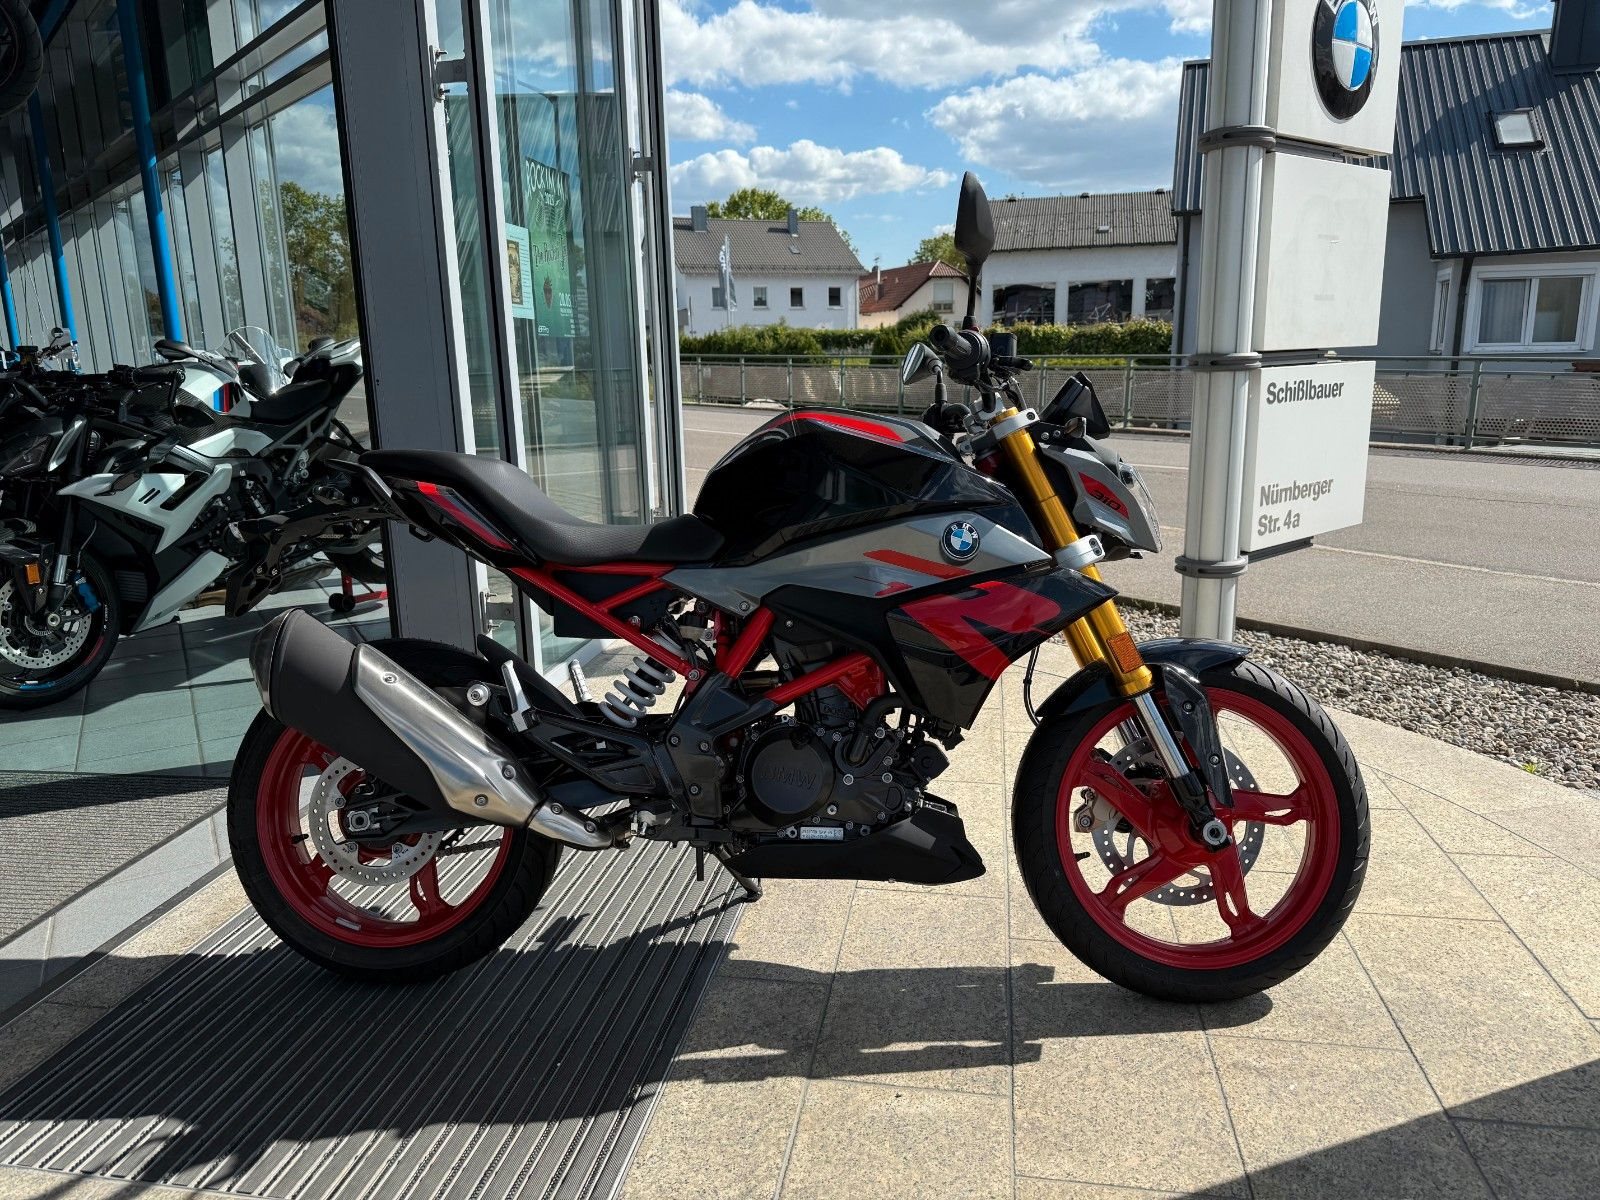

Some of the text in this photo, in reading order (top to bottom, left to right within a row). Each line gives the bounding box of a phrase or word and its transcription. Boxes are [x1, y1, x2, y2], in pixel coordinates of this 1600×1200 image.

[1266, 379, 1344, 405] Schißlbauer
[1090, 489, 1121, 511] 310
[1260, 478, 1334, 507] Nürnberger
[951, 522, 979, 539] BMW
[1257, 509, 1300, 536] Str. 4a
